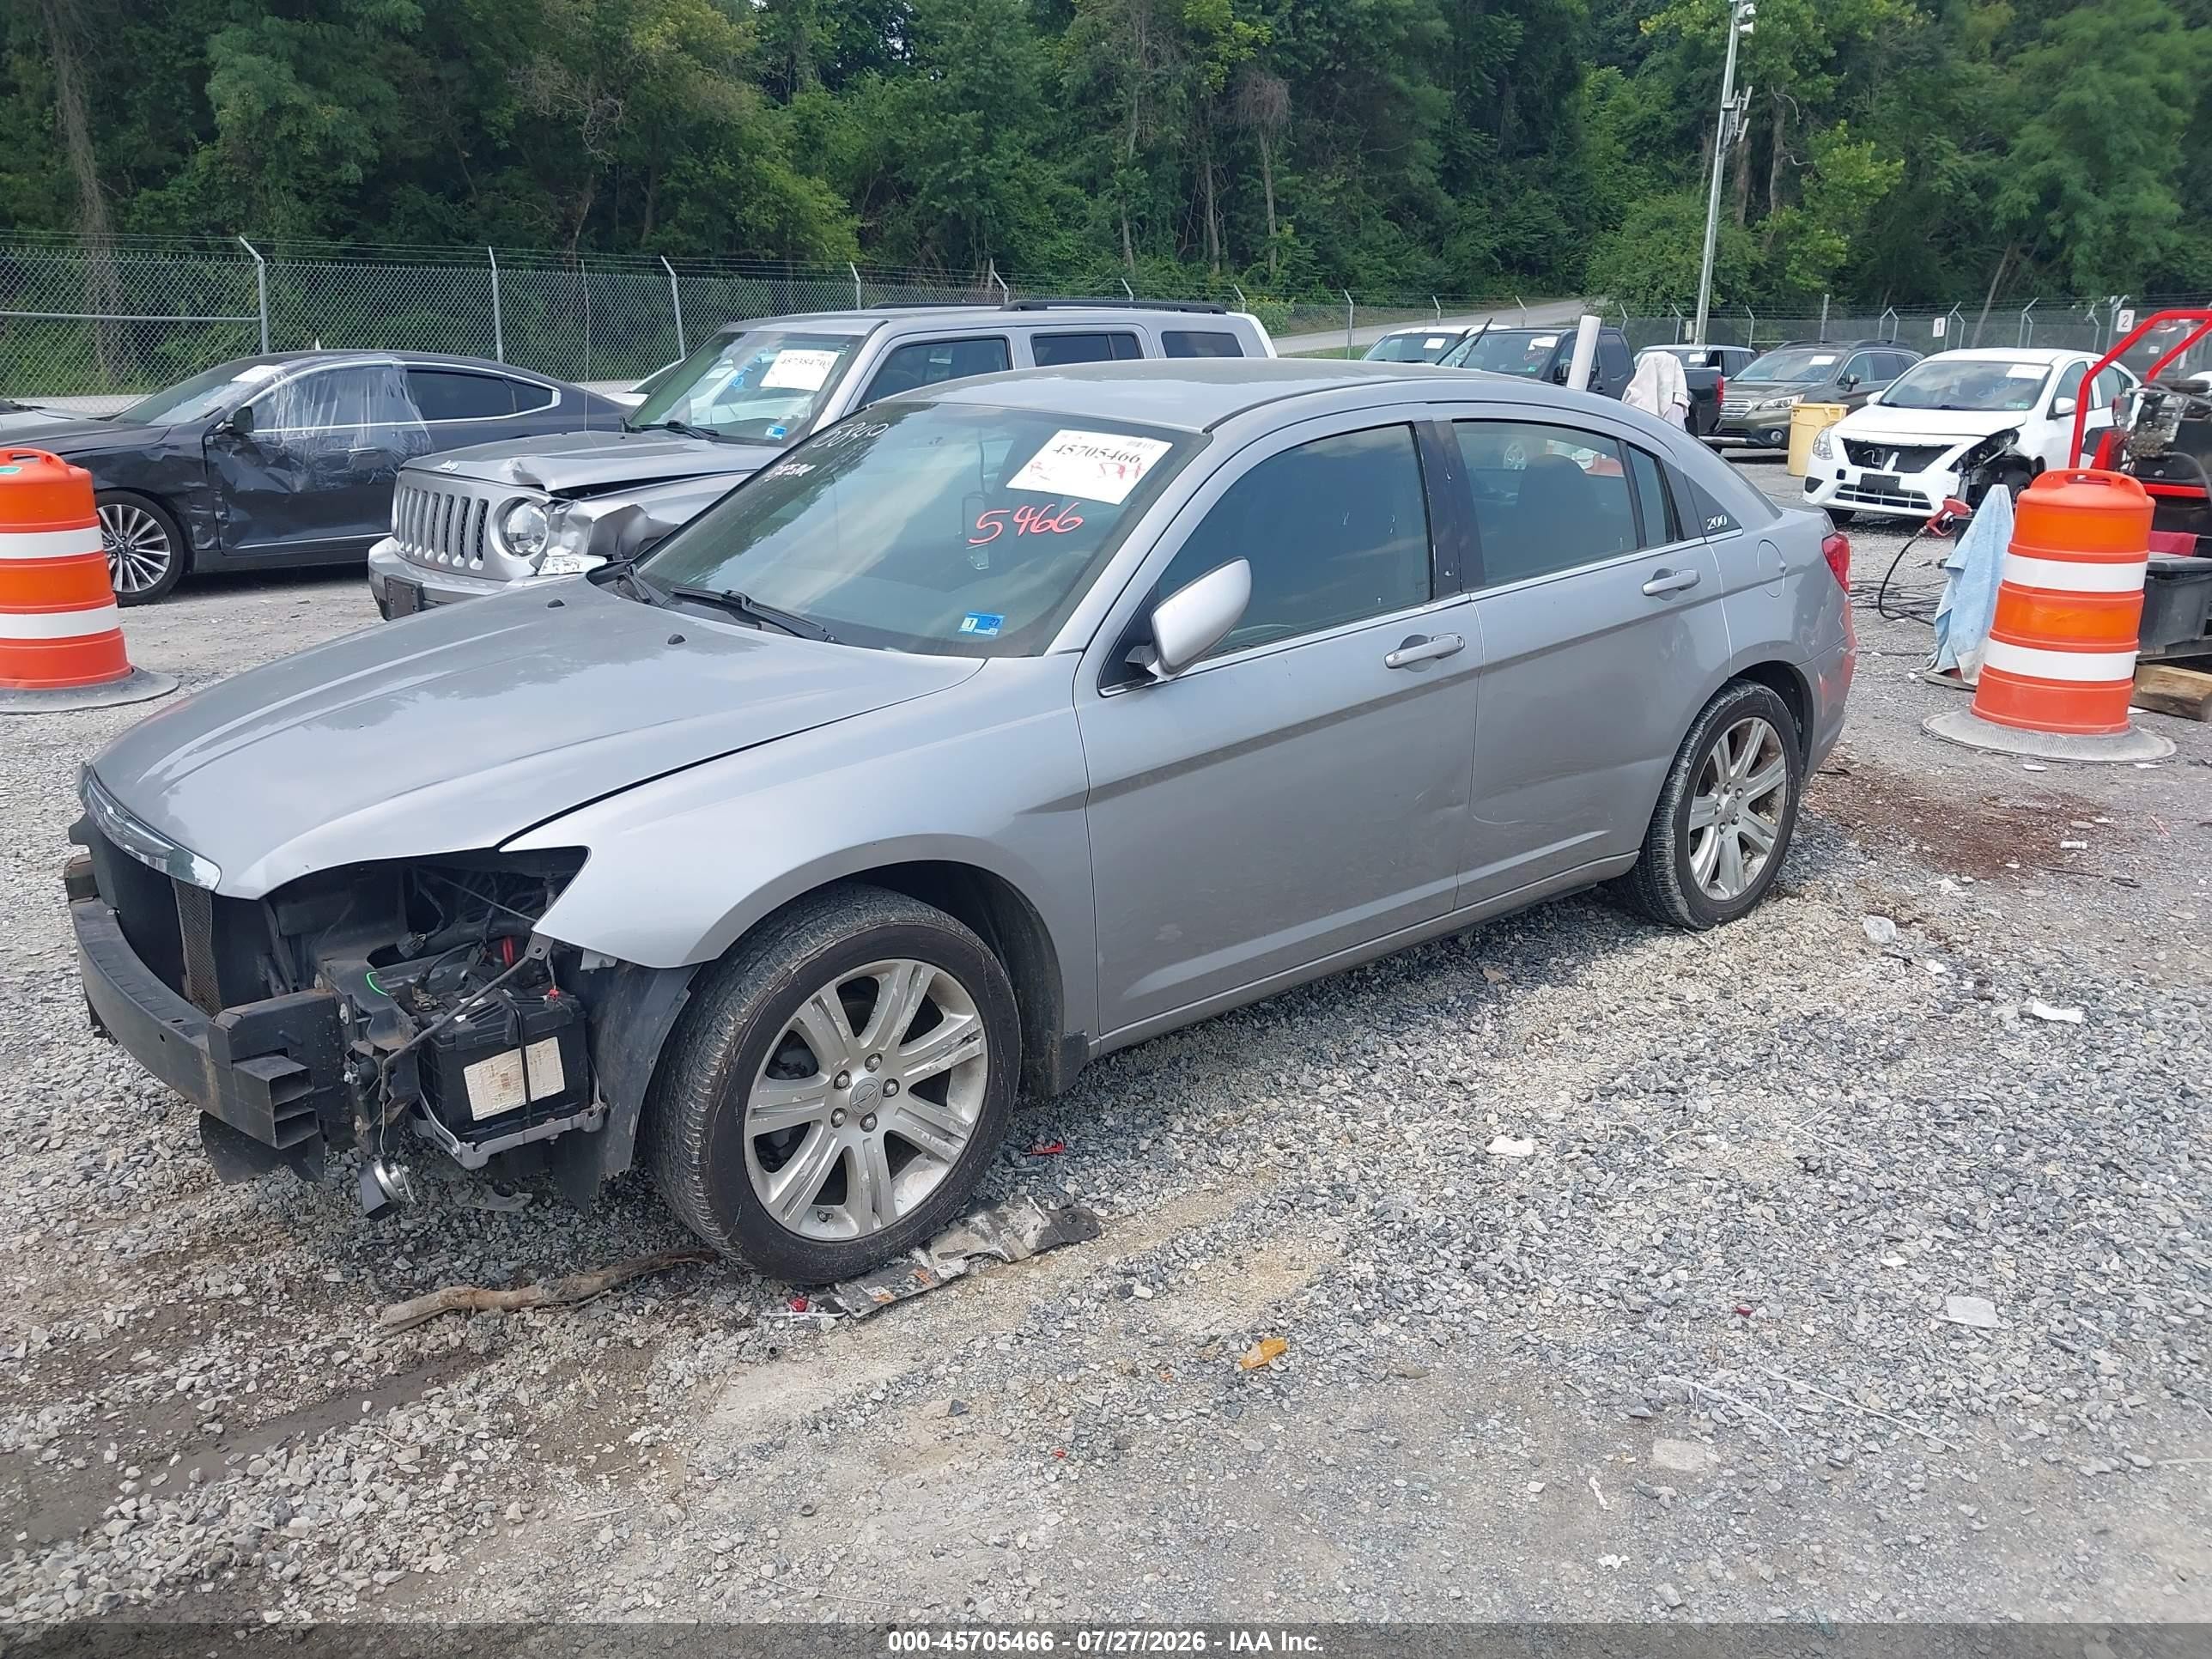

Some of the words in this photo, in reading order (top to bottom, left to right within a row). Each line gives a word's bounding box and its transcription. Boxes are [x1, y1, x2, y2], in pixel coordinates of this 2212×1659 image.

[2121, 314, 2129, 328] 2
[1052, 443, 1141, 464] 45705466
[968, 501, 1085, 544] 5466
[1706, 514, 1728, 531] 200
